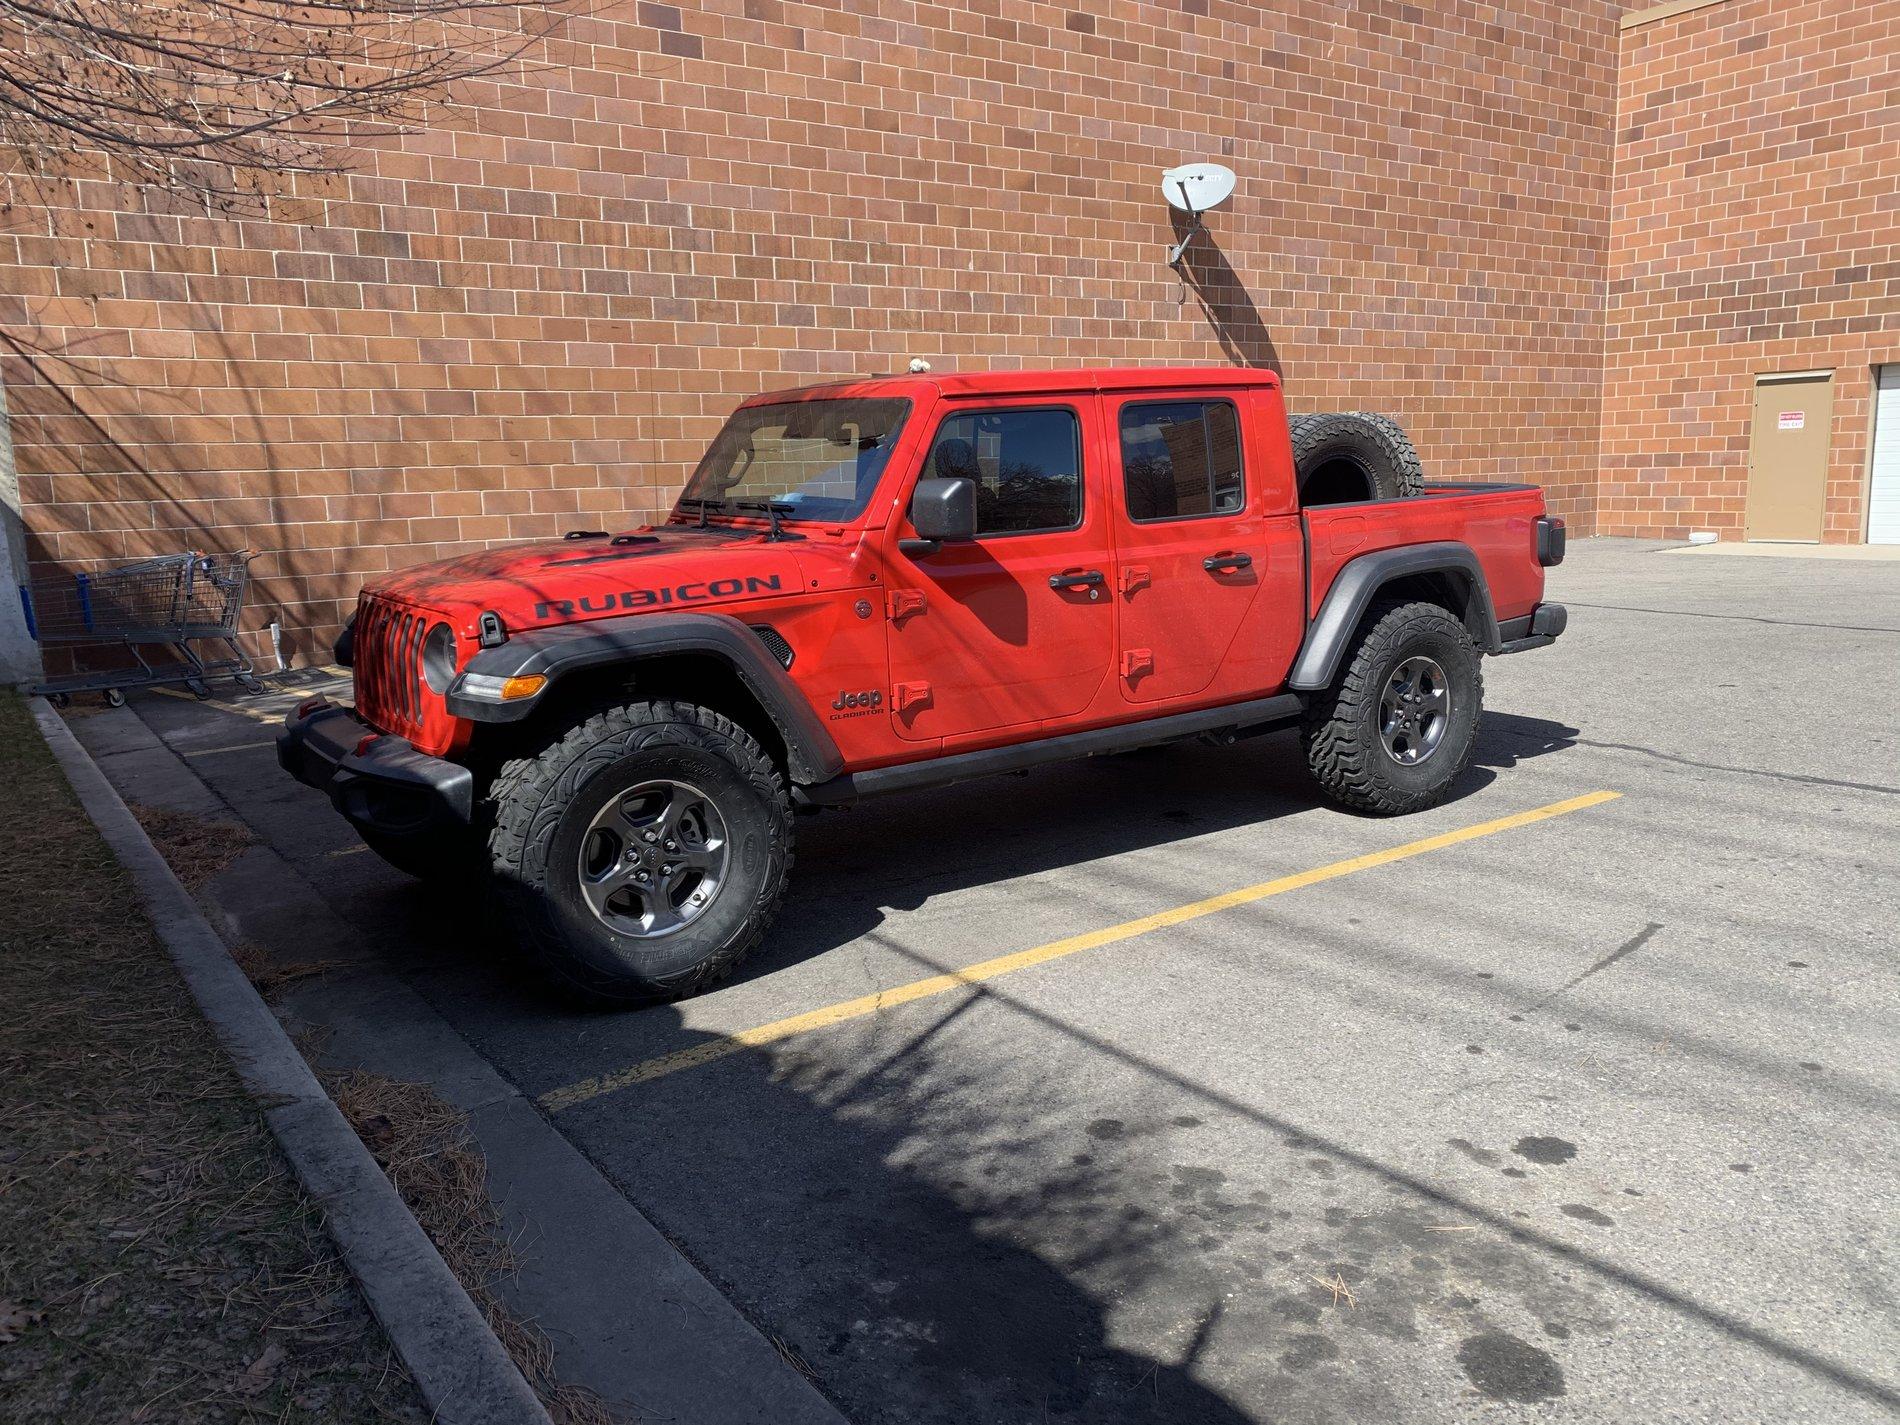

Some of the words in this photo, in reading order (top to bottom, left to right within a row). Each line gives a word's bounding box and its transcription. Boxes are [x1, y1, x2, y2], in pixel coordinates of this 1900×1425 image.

[533, 574, 781, 619] RUBICON
[832, 689, 883, 711] Jeep
[829, 708, 884, 721] GLADIATOR
